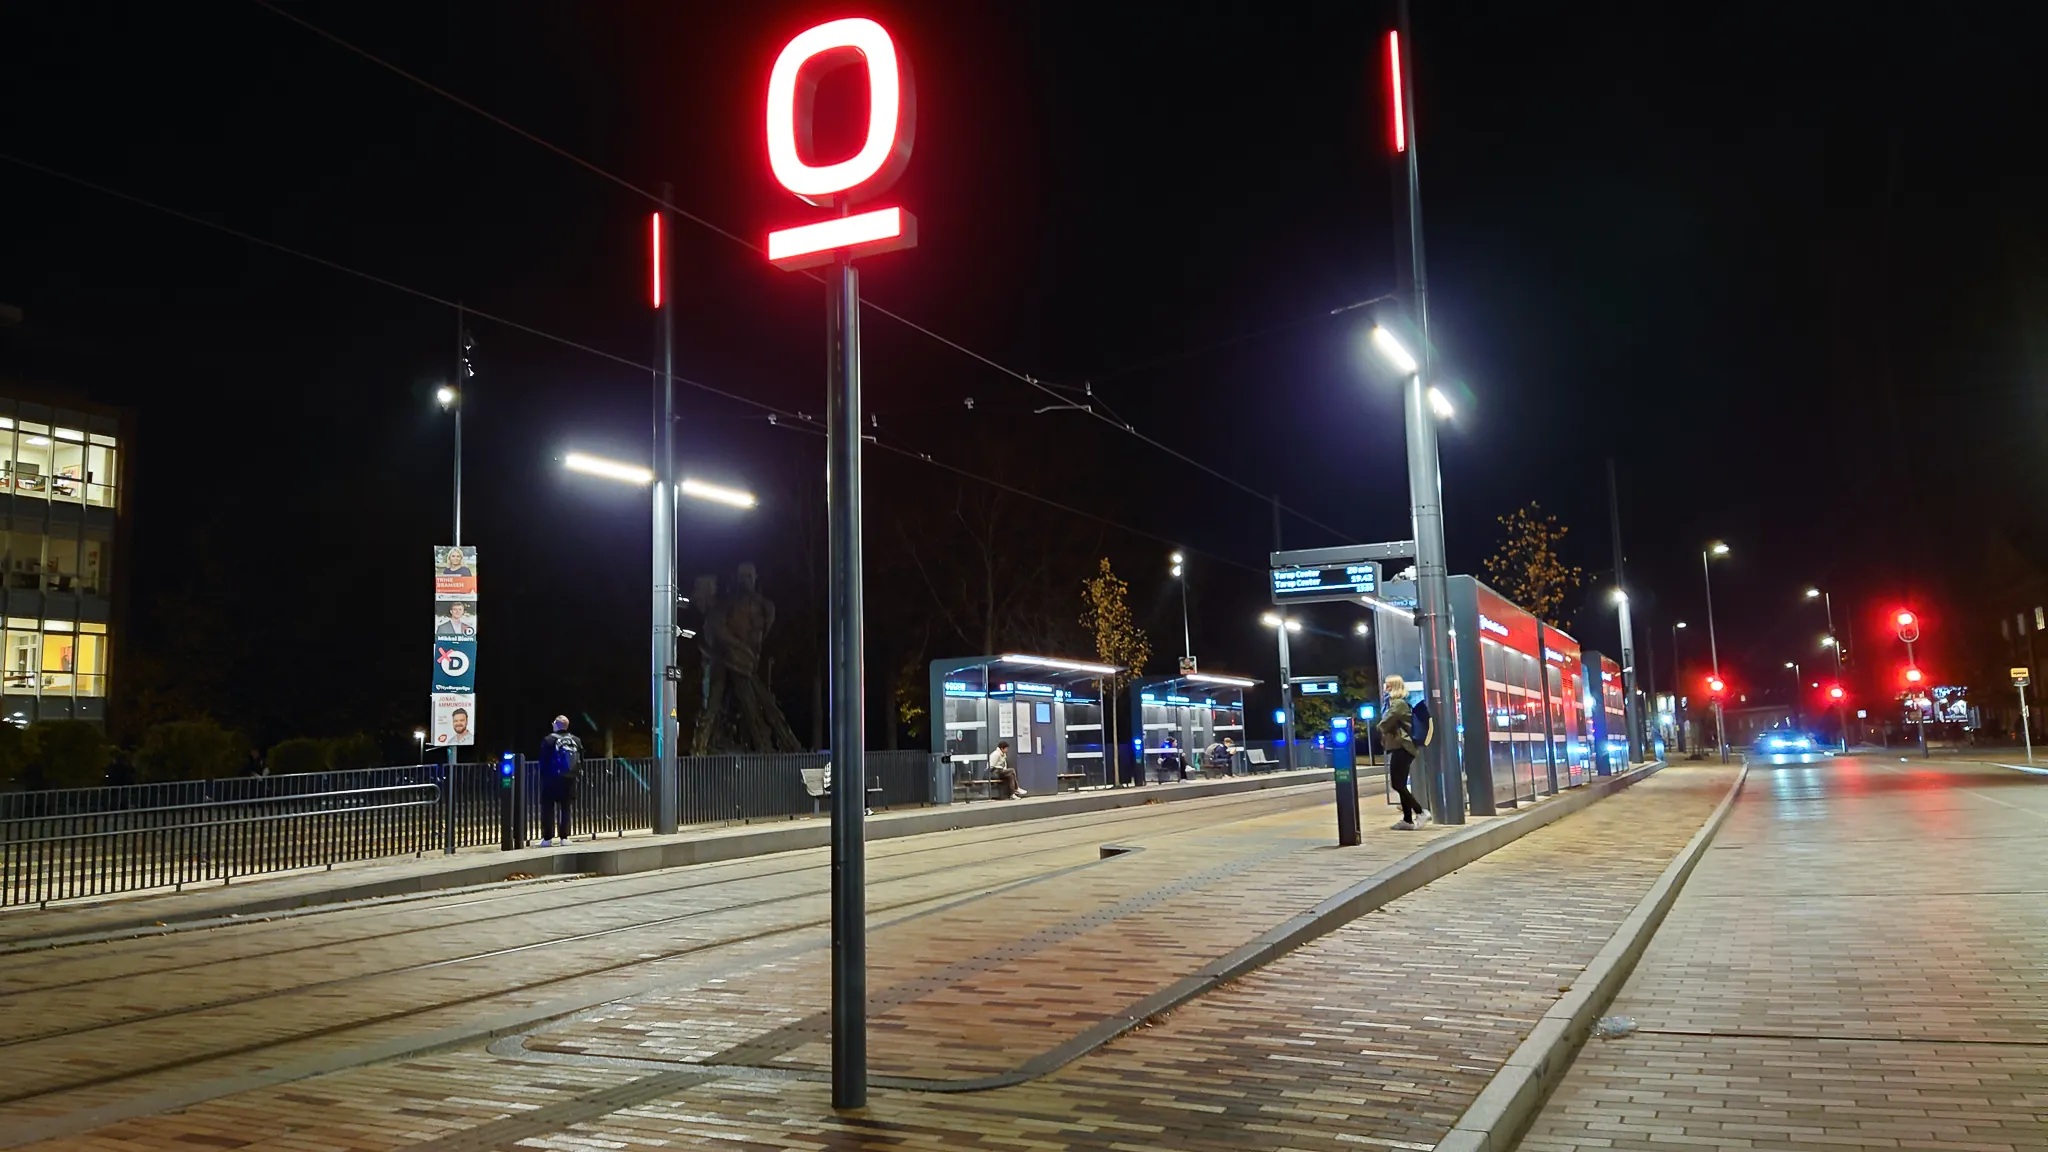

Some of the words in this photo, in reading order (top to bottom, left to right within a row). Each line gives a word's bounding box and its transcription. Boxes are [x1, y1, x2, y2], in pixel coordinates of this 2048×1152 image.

[1274, 572, 1295, 580] Tarup
[1296, 570, 1320, 578] Center
[1275, 580, 1296, 588] Tarup
